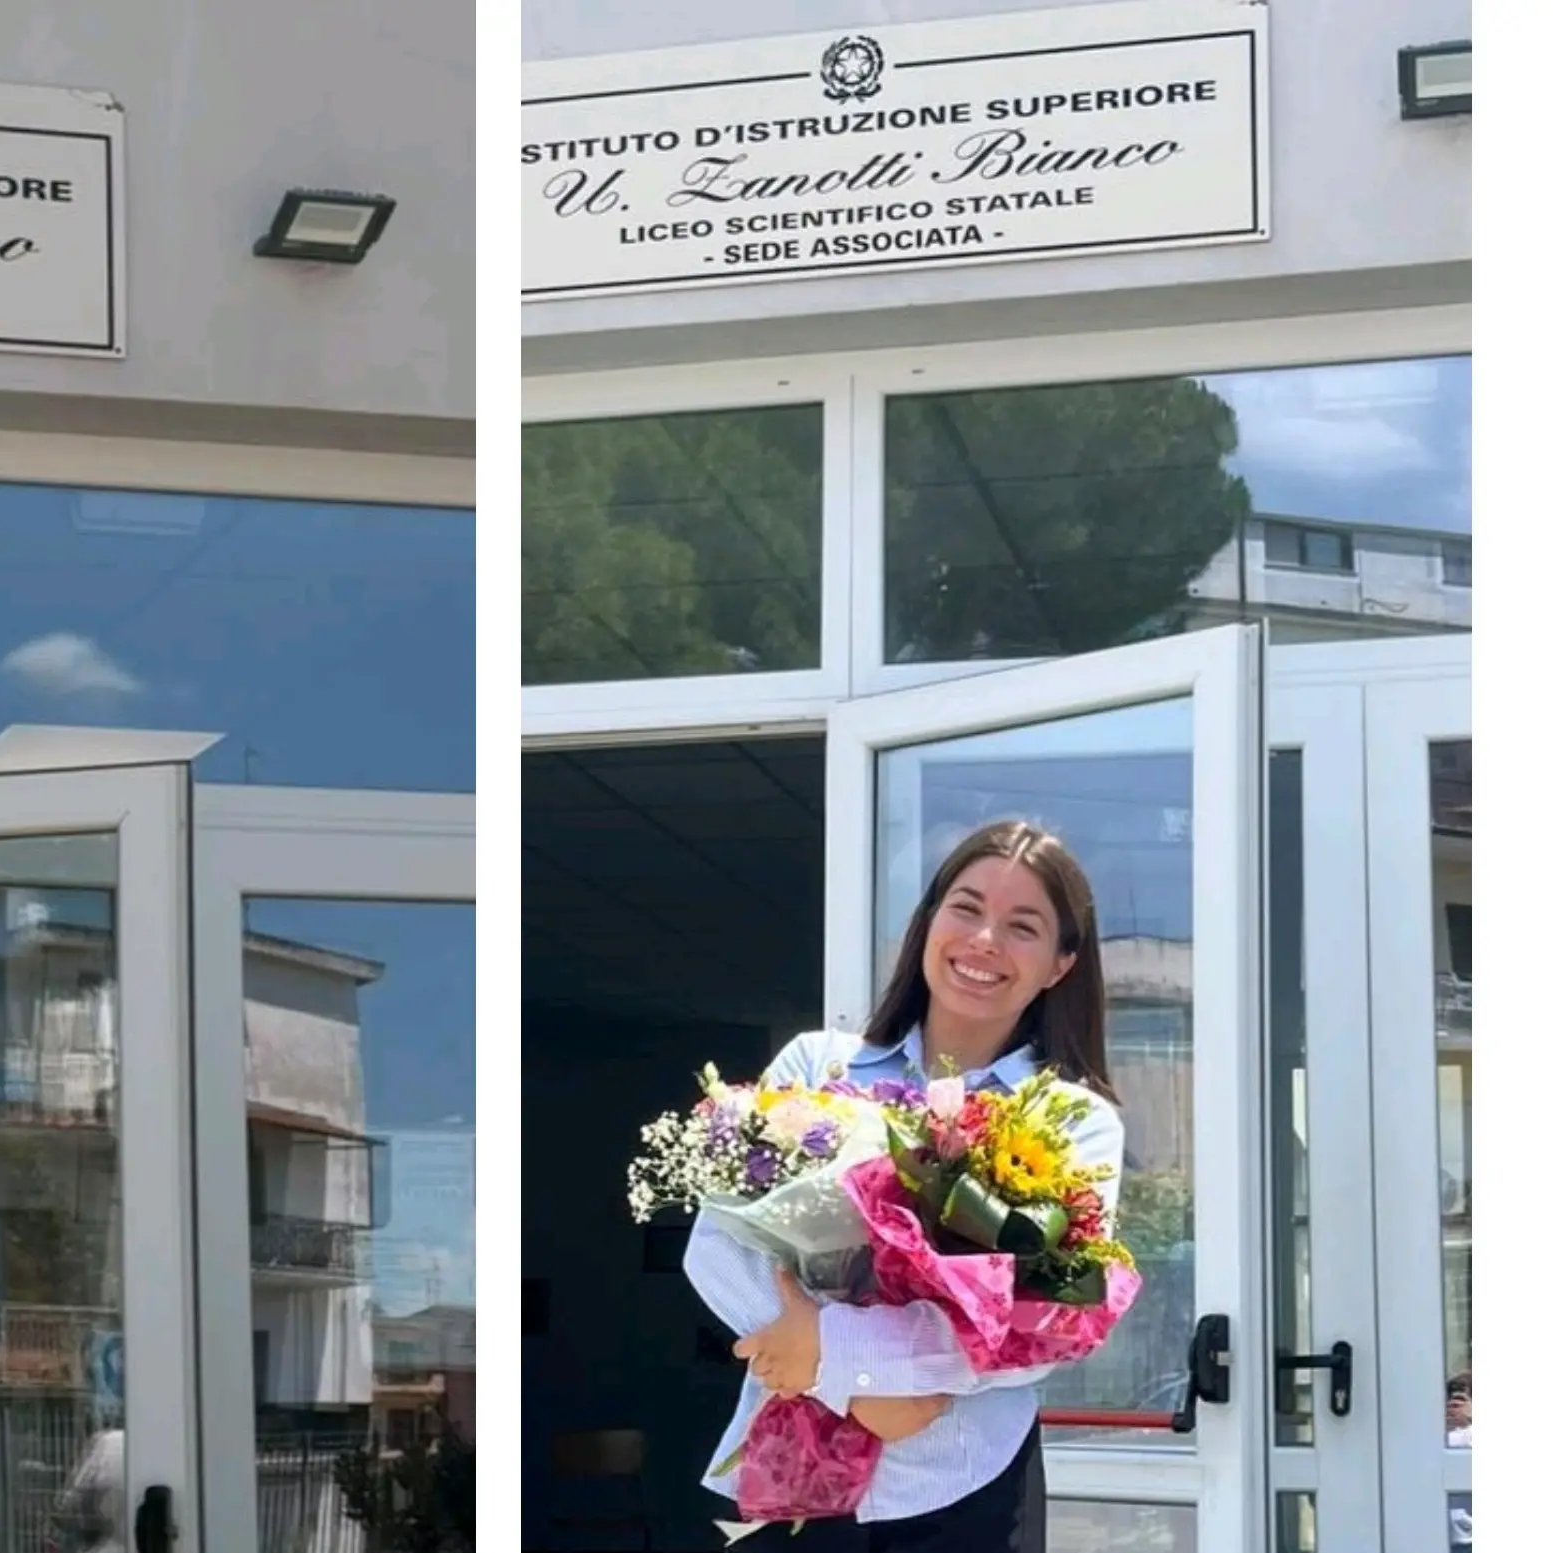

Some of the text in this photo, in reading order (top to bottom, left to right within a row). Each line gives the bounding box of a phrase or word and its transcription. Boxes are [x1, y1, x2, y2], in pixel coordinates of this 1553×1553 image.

[521, 79, 1217, 165] STITUTO D'ISTRUZIONE SUPERIORE
[545, 128, 1178, 219] U. Zanotti Bianco
[619, 186, 1094, 245] LICEO SCIENTIFICO STATALE
[723, 239, 800, 265] SEDE
[810, 225, 983, 260] ASSOCIATA
